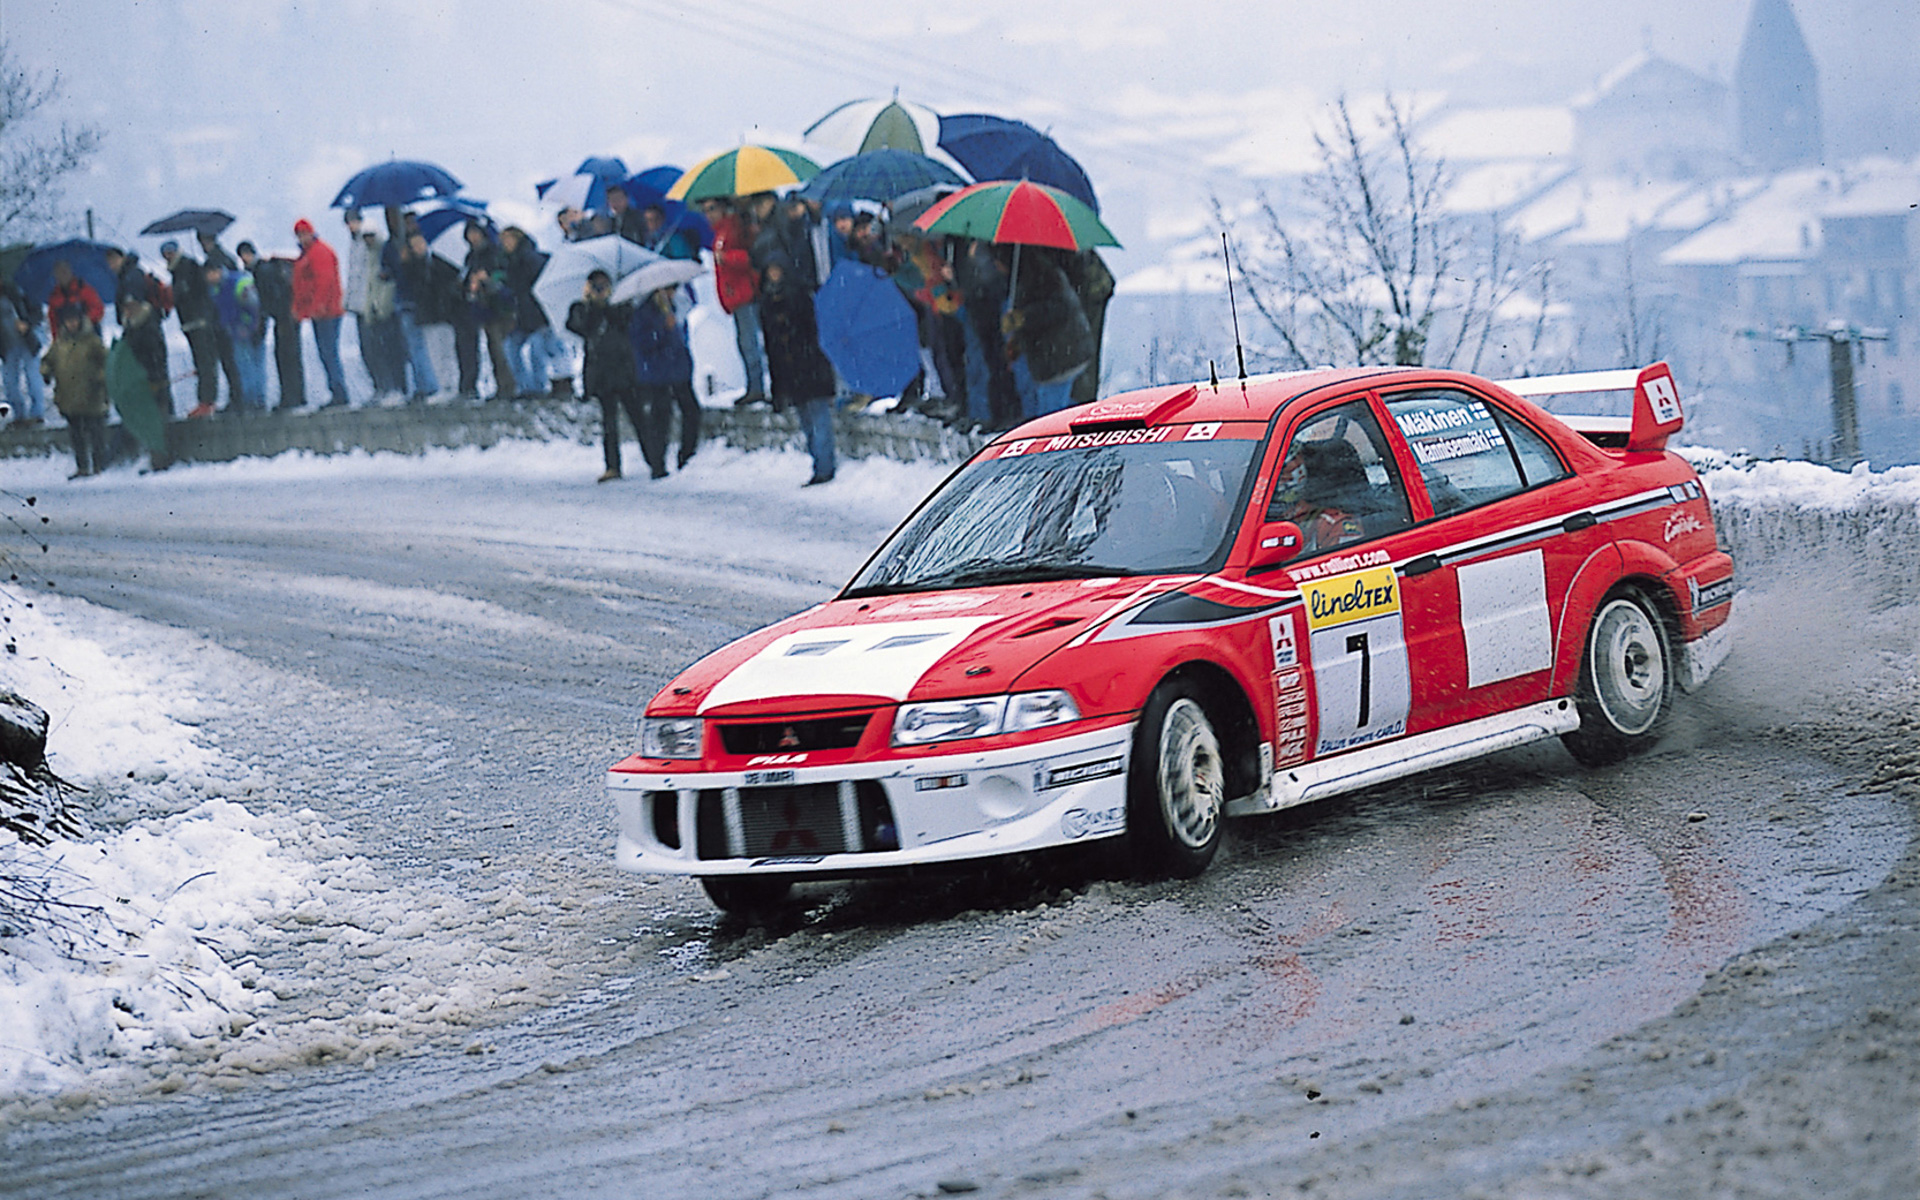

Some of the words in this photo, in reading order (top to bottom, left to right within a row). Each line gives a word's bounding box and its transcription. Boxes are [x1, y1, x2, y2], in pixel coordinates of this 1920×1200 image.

[1396, 408, 1473, 437] Mäkinen
[1044, 426, 1173, 452] MITSUBISHI
[1346, 633, 1370, 728] 7
[746, 753, 809, 766] PIAA
